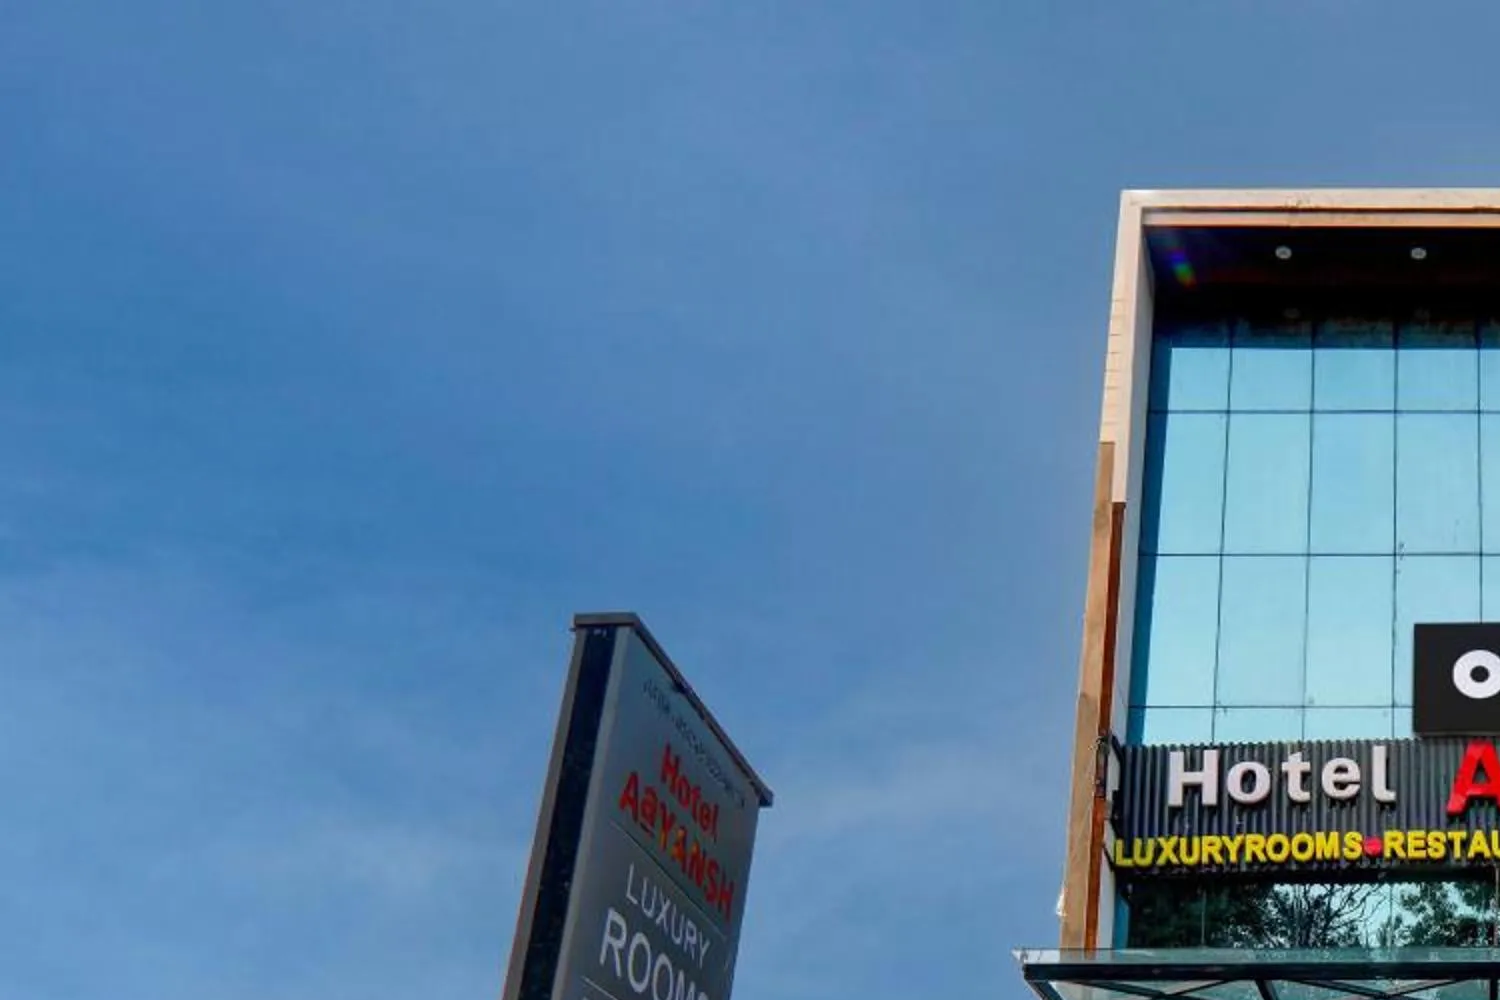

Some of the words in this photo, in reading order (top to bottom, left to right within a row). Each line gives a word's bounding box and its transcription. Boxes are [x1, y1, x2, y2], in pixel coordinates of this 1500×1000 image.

[660, 743, 719, 842] Hotel
[1168, 745, 1396, 807] Hotel
[625, 862, 710, 969] LUXURY
